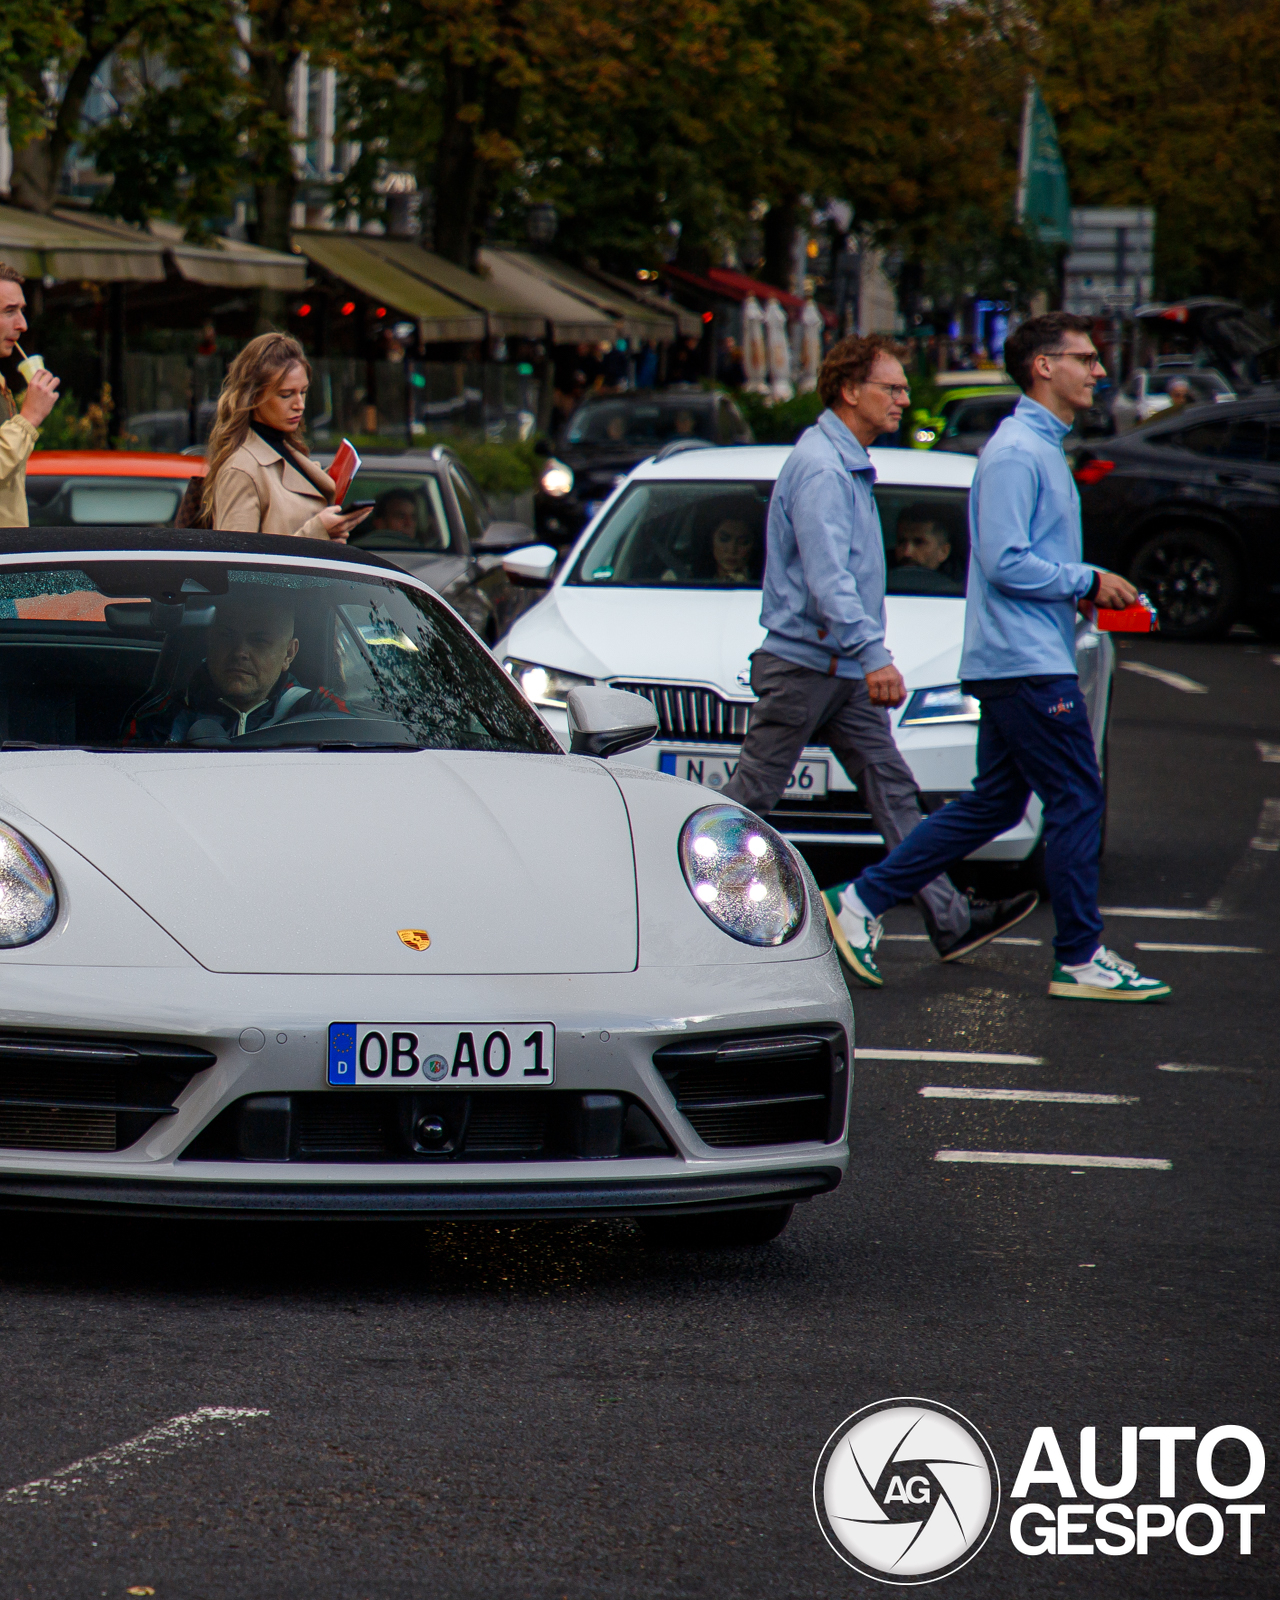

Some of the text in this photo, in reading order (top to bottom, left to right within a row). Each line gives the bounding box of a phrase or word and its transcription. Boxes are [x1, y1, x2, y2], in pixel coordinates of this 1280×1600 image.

[687, 759, 704, 785] N
[359, 1031, 550, 1078] OB AO 1
[337, 1061, 348, 1075] D
